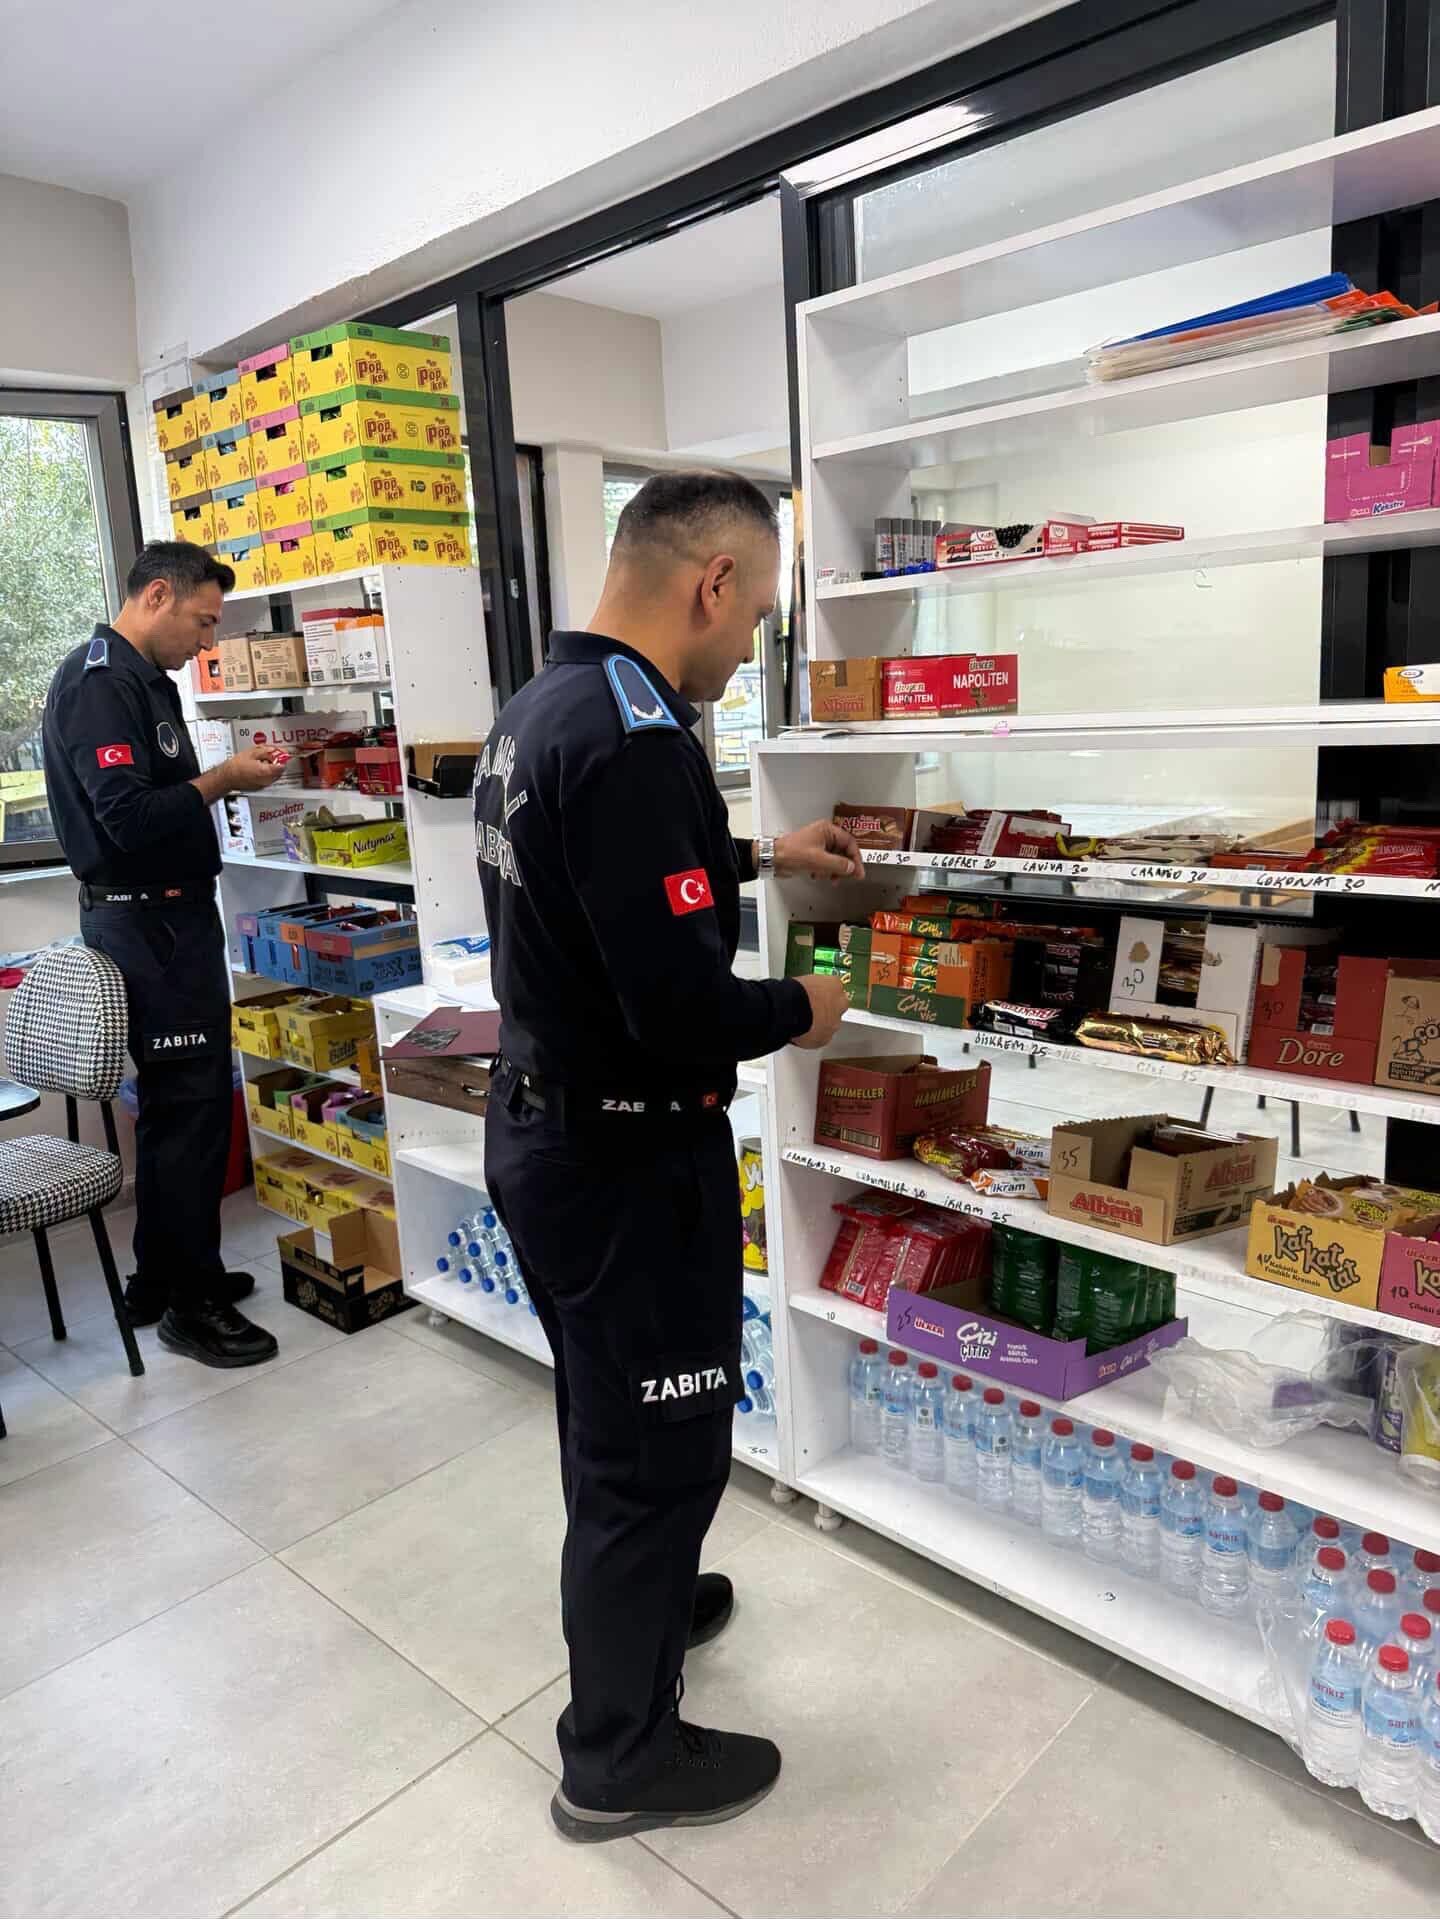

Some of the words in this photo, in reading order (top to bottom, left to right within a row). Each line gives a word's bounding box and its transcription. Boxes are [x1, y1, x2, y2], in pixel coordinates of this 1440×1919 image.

[356, 358, 383, 379] Pop
[417, 366, 441, 386] Pop
[365, 418, 391, 440] Pop
[426, 424, 450, 444] Pop
[371, 477, 397, 498] Pop
[432, 480, 457, 501] Pop
[376, 536, 400, 557] Pop
[435, 539, 459, 560] Pop
[1342, 878, 1366, 892] 30
[152, 1032, 208, 1050] ZABITA
[1276, 1037, 1345, 1067] Dore
[1070, 1191, 1144, 1229] Albeni
[640, 1366, 729, 1404] ZABITA
